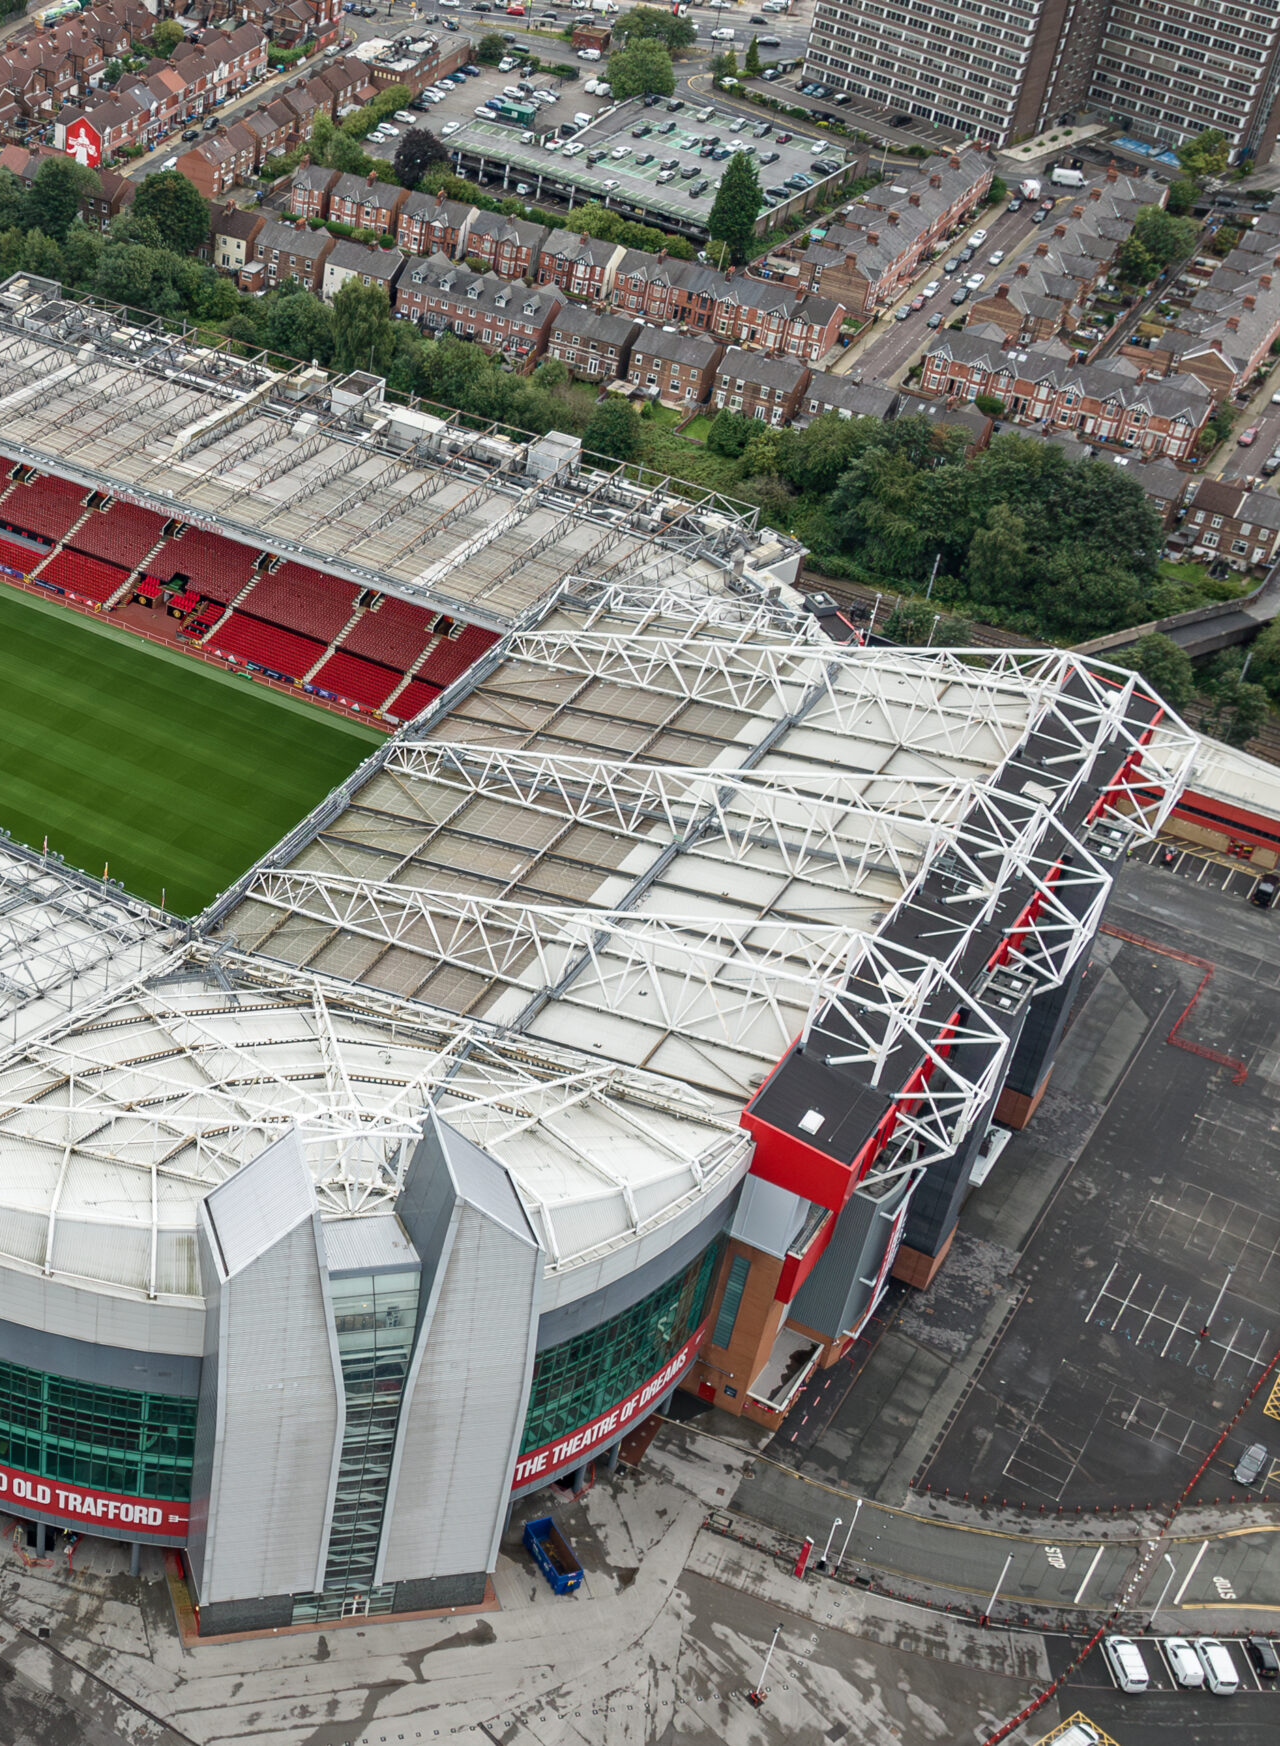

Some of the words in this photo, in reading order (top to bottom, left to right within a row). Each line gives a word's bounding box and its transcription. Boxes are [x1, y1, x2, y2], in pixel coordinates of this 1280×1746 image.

[97, 484, 111, 495] SIR
[113, 490, 141, 505] BOBBY
[144, 501, 191, 523] CHARLTON
[194, 518, 224, 535] STAND
[515, 1451, 549, 1481] THE
[552, 1409, 620, 1464] THEATRE
[620, 1394, 639, 1422] OF
[638, 1347, 689, 1407] DREAMS
[12, 1478, 51, 1505] OLD
[55, 1489, 163, 1526] TRAFFORD
[1044, 1546, 1067, 1569] STOP
[1212, 1575, 1237, 1600] STOP
